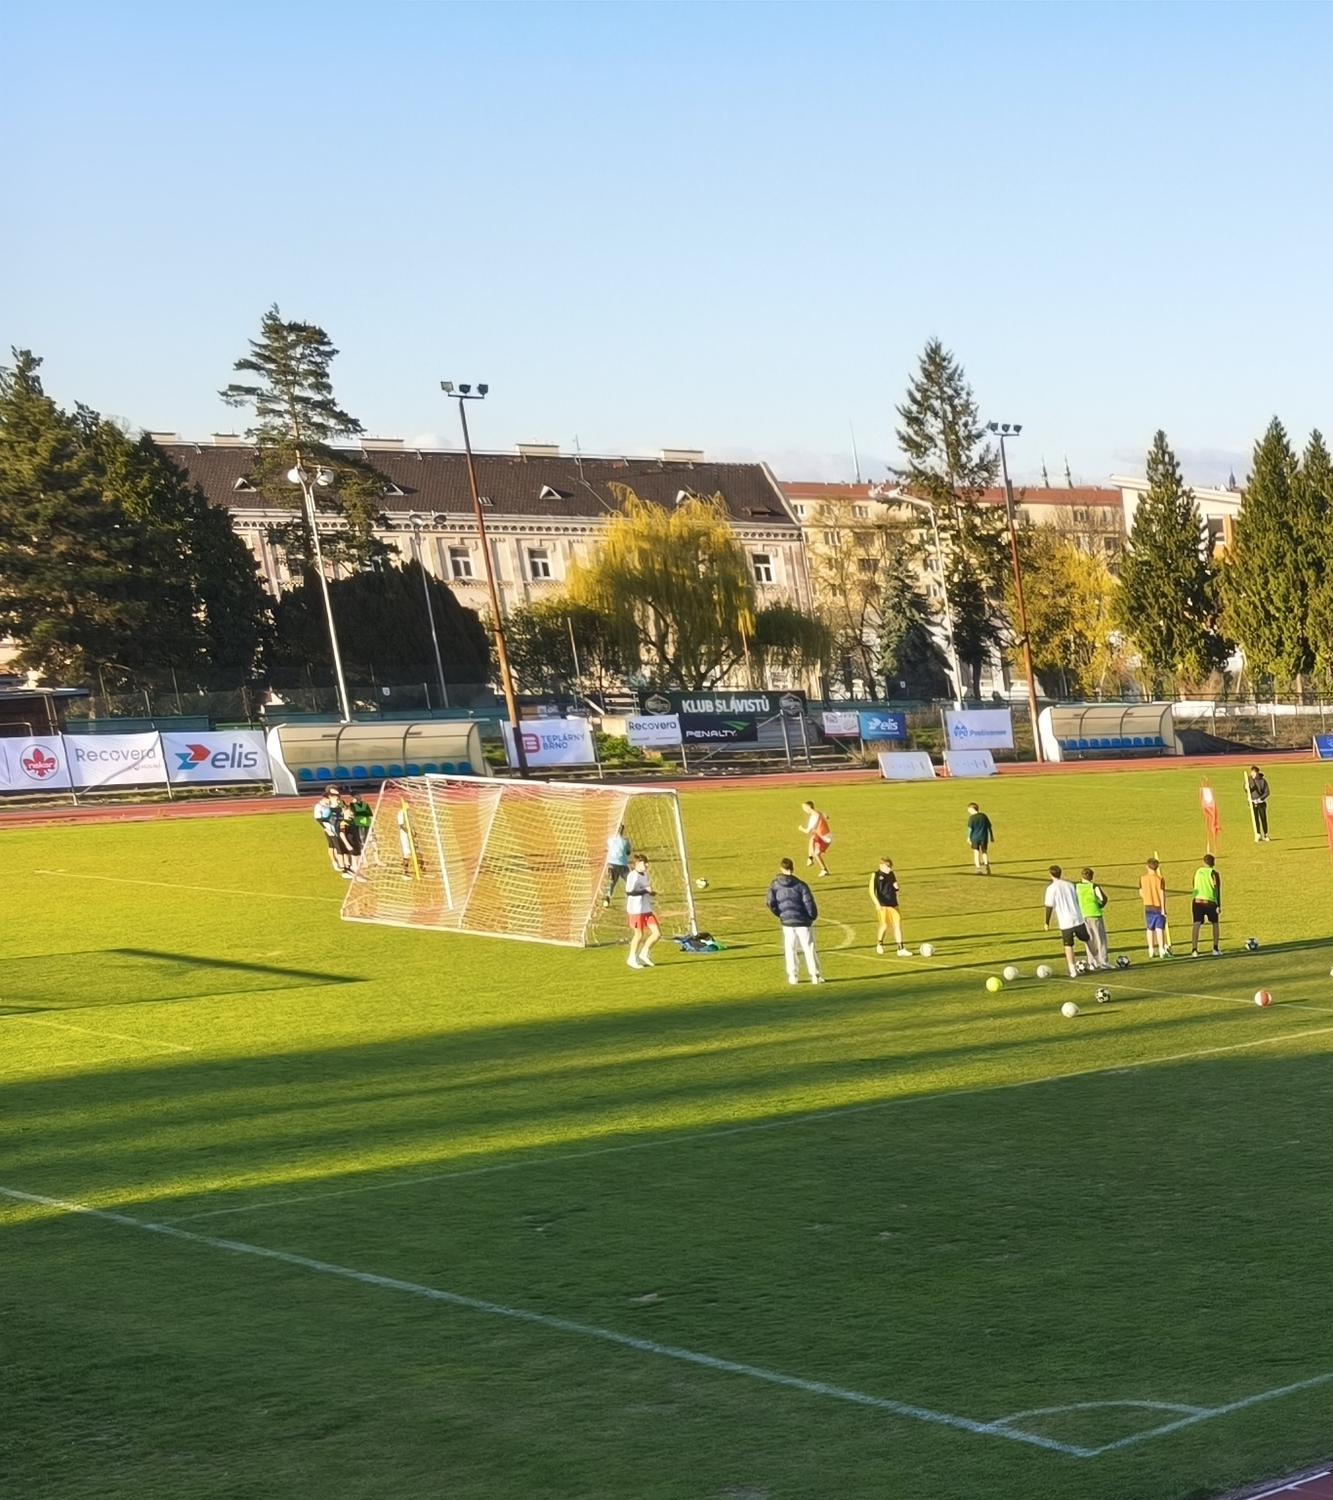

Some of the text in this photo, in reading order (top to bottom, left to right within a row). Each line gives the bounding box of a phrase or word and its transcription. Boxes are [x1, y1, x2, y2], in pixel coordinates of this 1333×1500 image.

[682, 699, 714, 713] KLUB
[629, 721, 676, 731] Recovera
[540, 732, 585, 743] TEPLÁRNY
[686, 729, 736, 738] PENALTY
[543, 742, 568, 750] BRNO
[75, 746, 156, 762] Recovera
[211, 743, 258, 769] elis
